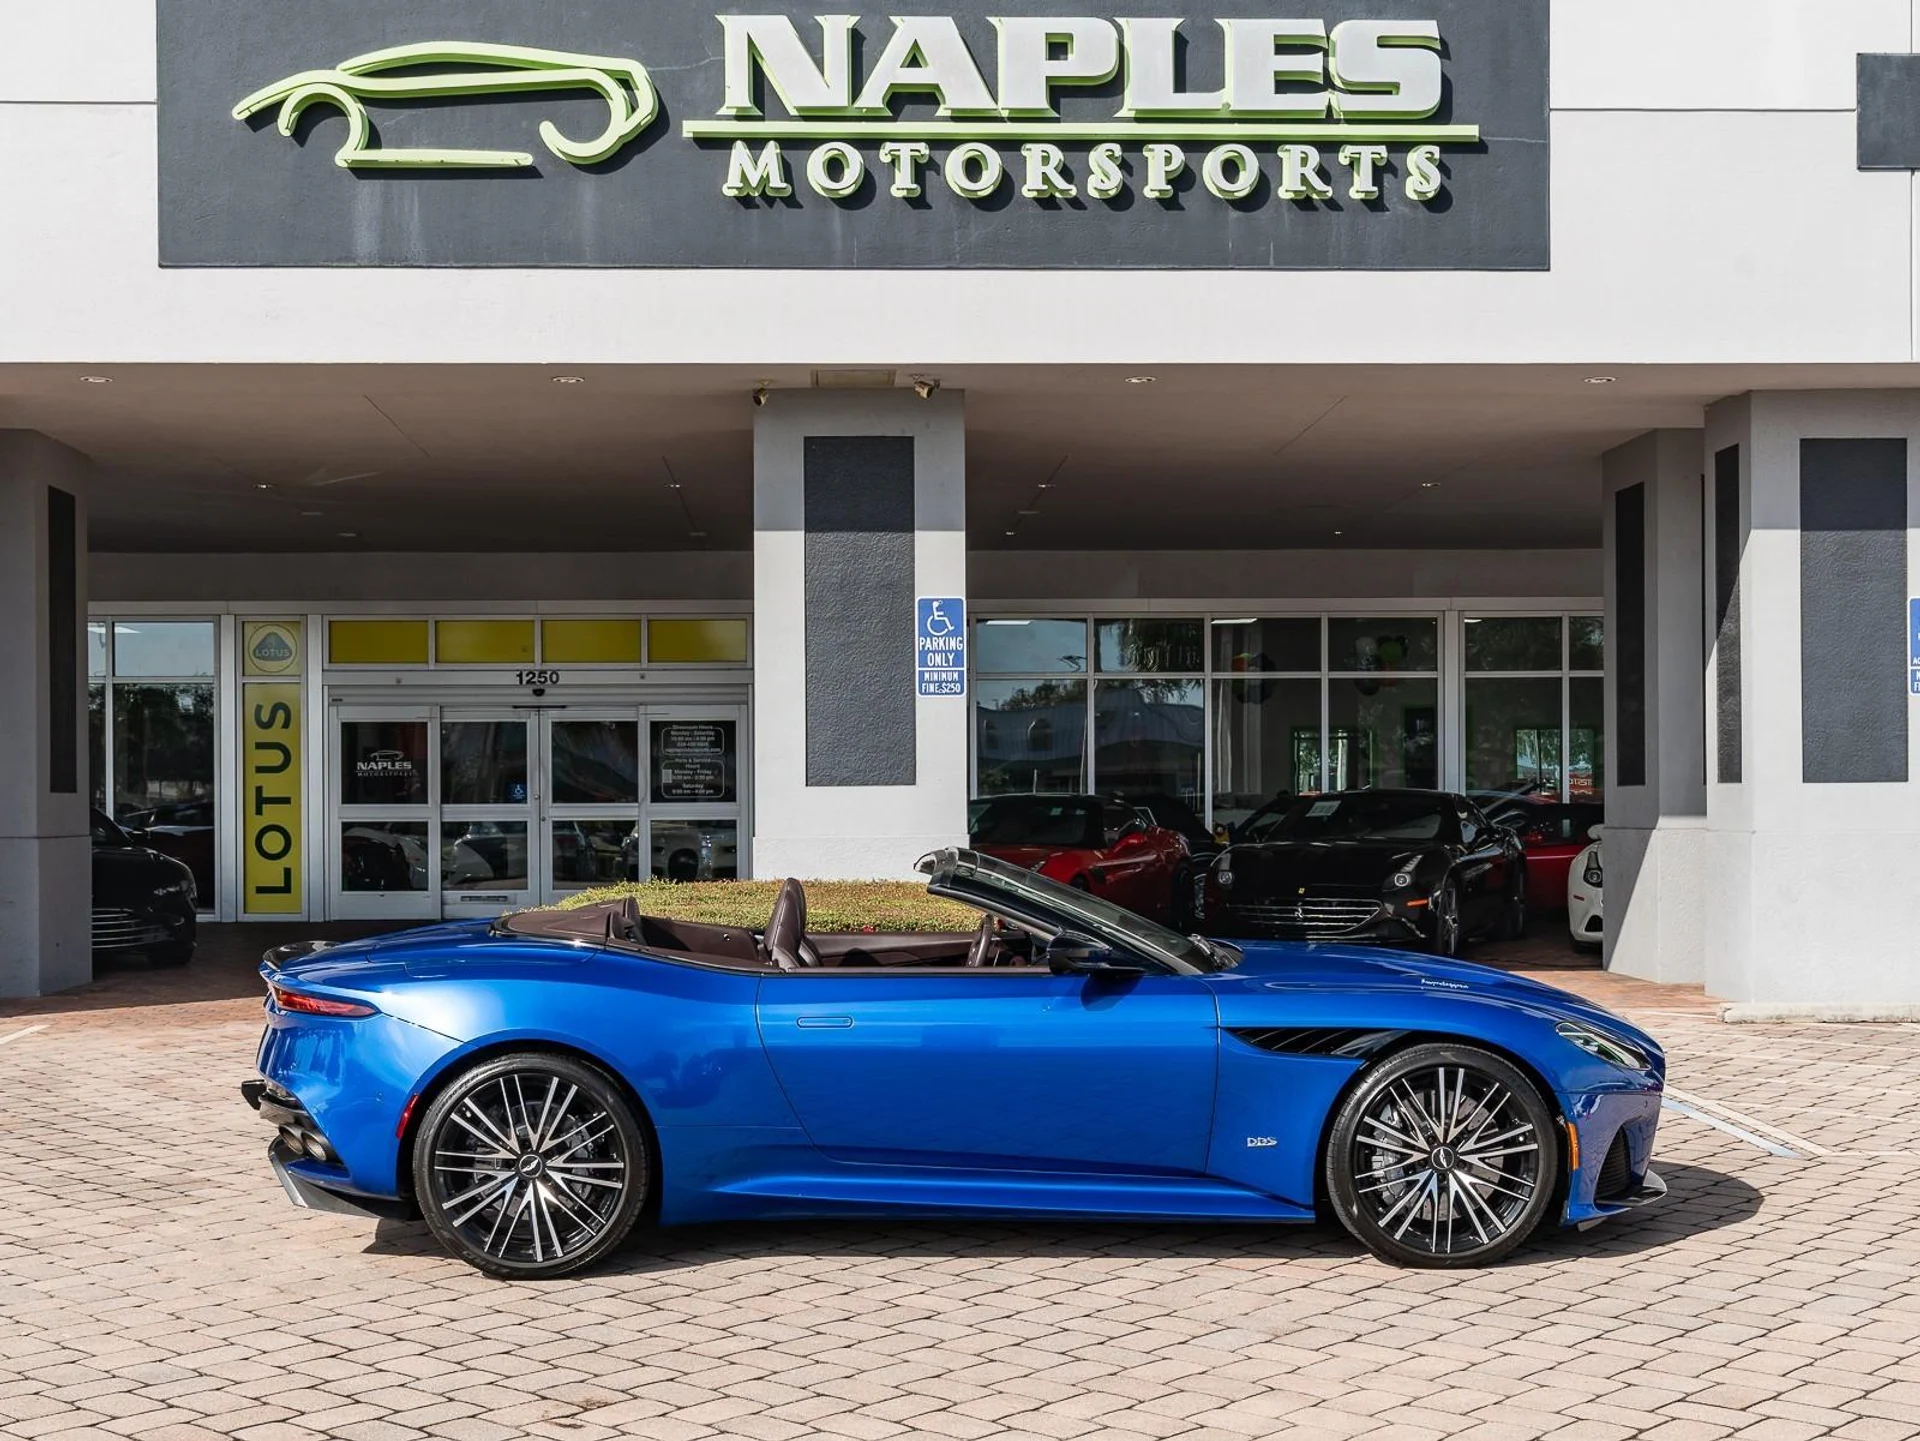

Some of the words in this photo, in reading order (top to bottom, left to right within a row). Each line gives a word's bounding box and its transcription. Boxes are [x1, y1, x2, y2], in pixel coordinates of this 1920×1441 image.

[715, 14, 1442, 120] NAPLES
[722, 140, 1442, 201] MOTORSPORTS
[919, 636, 963, 651] PARKING
[255, 649, 290, 658] LOTUS
[927, 652, 955, 667] ONLY
[516, 669, 560, 685] 1250
[924, 671, 959, 682] MINIMUM
[357, 761, 412, 770] NAPLES
[254, 701, 292, 894] LOTUS
[1247, 1136, 1278, 1148] DBS
